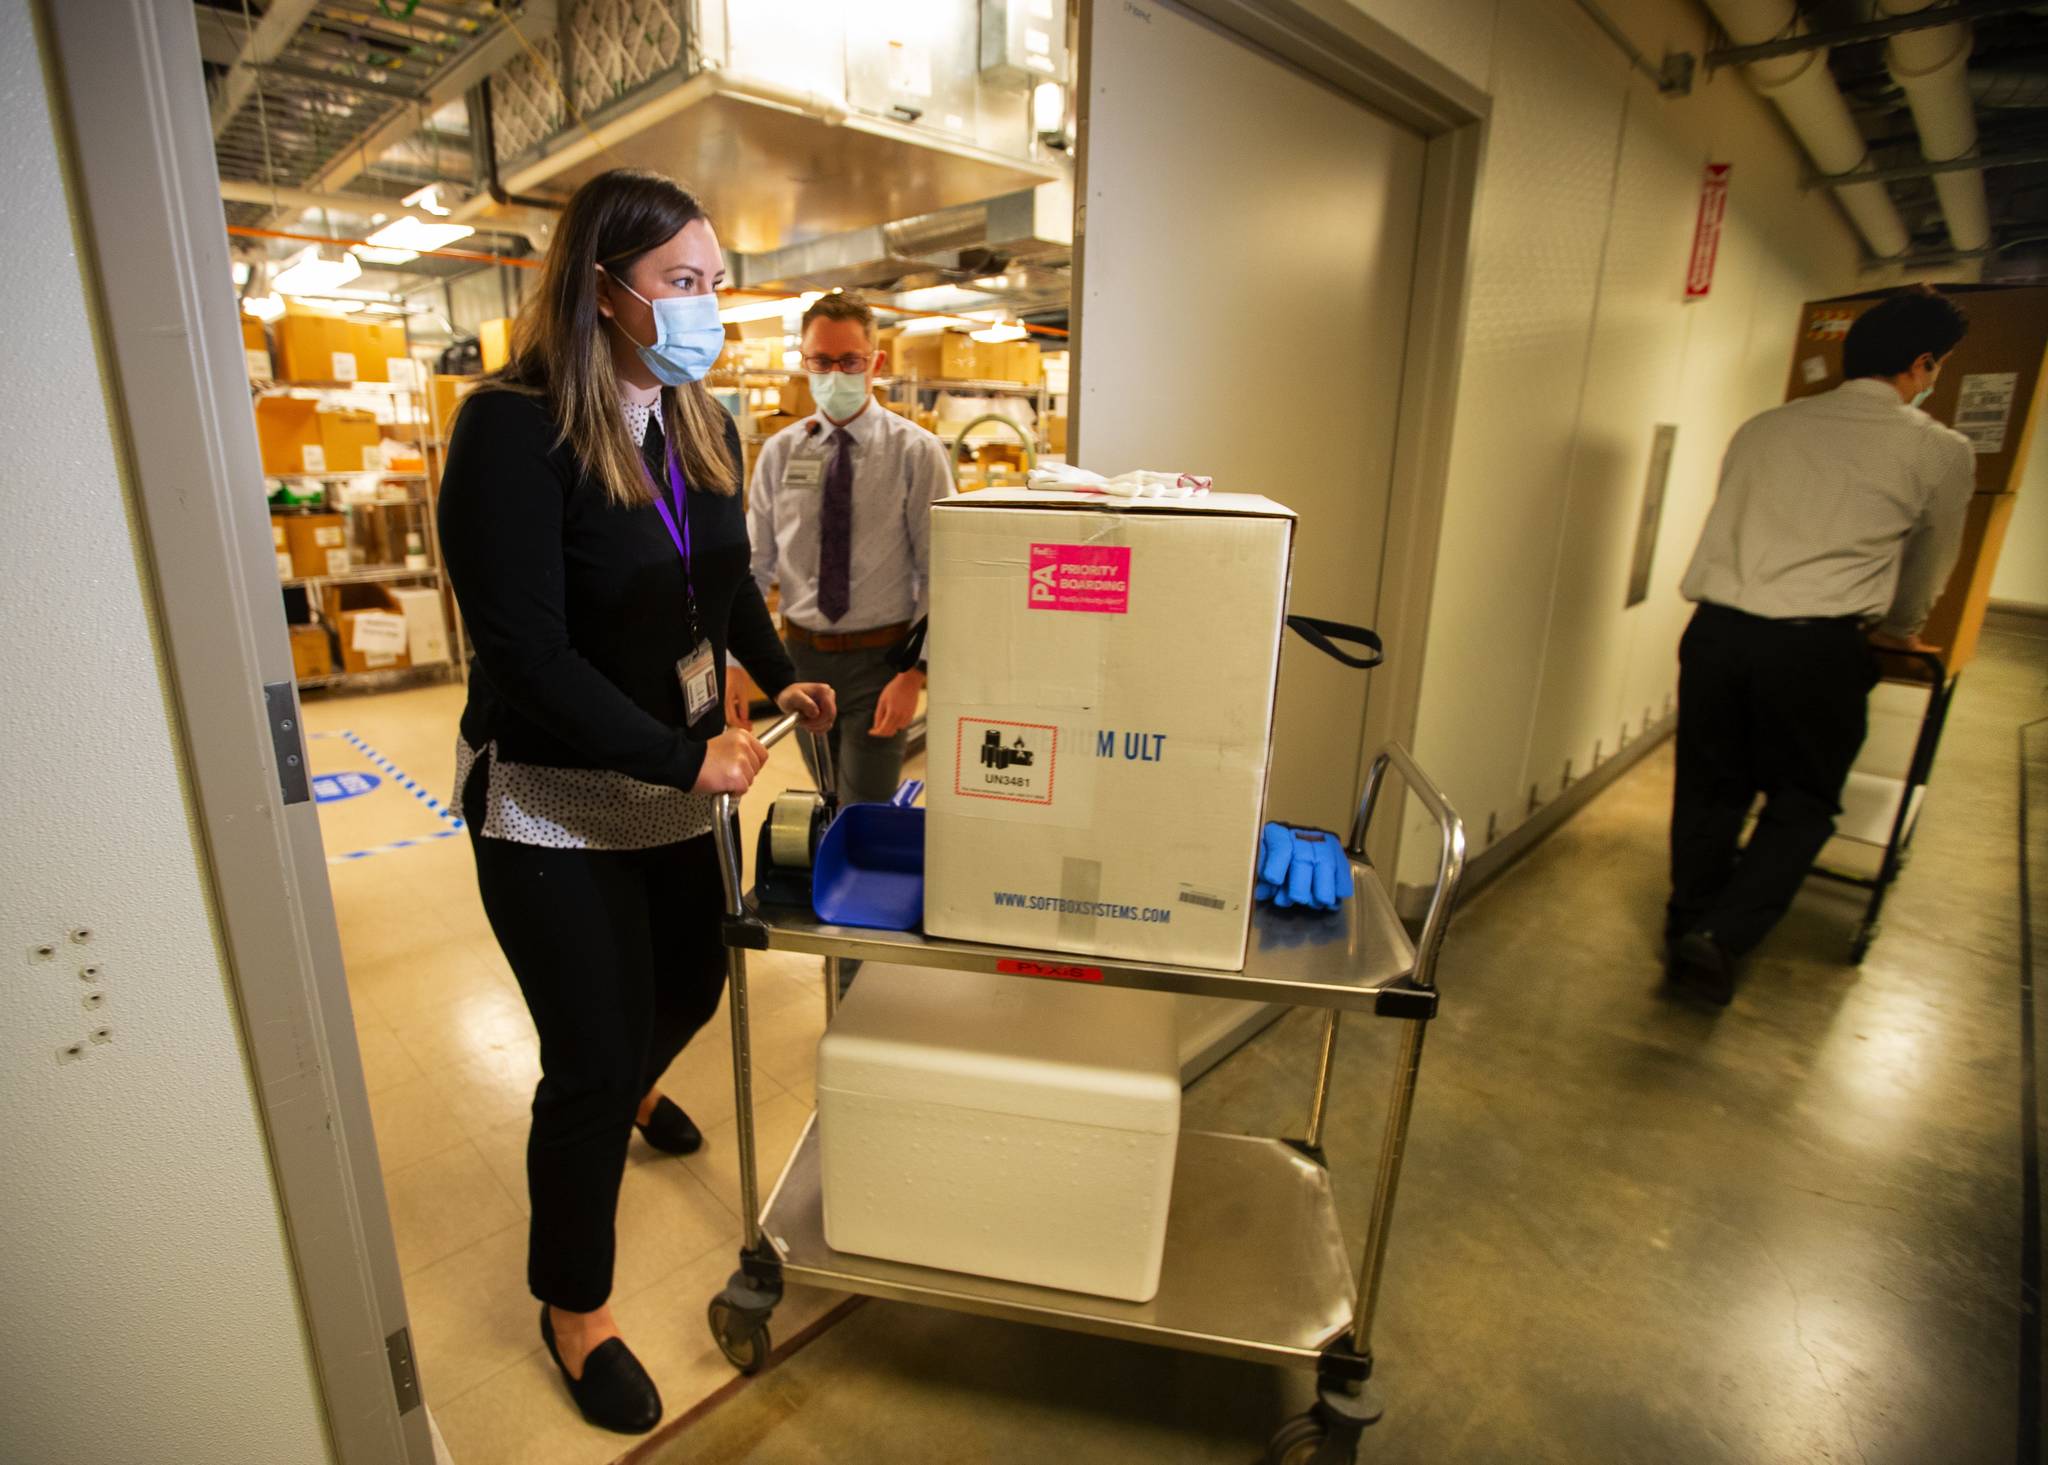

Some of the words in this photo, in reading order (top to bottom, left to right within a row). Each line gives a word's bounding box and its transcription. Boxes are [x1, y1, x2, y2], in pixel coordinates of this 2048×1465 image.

[1060, 564, 1118, 576] PRIORITY
[1031, 564, 1058, 601] PA
[1060, 578, 1126, 592] BOARDING
[1124, 732, 1167, 762] ULT
[984, 773, 1031, 788] UN3481
[993, 891, 1172, 924] WWW.SOFTBOXSYSTEMS.COM
